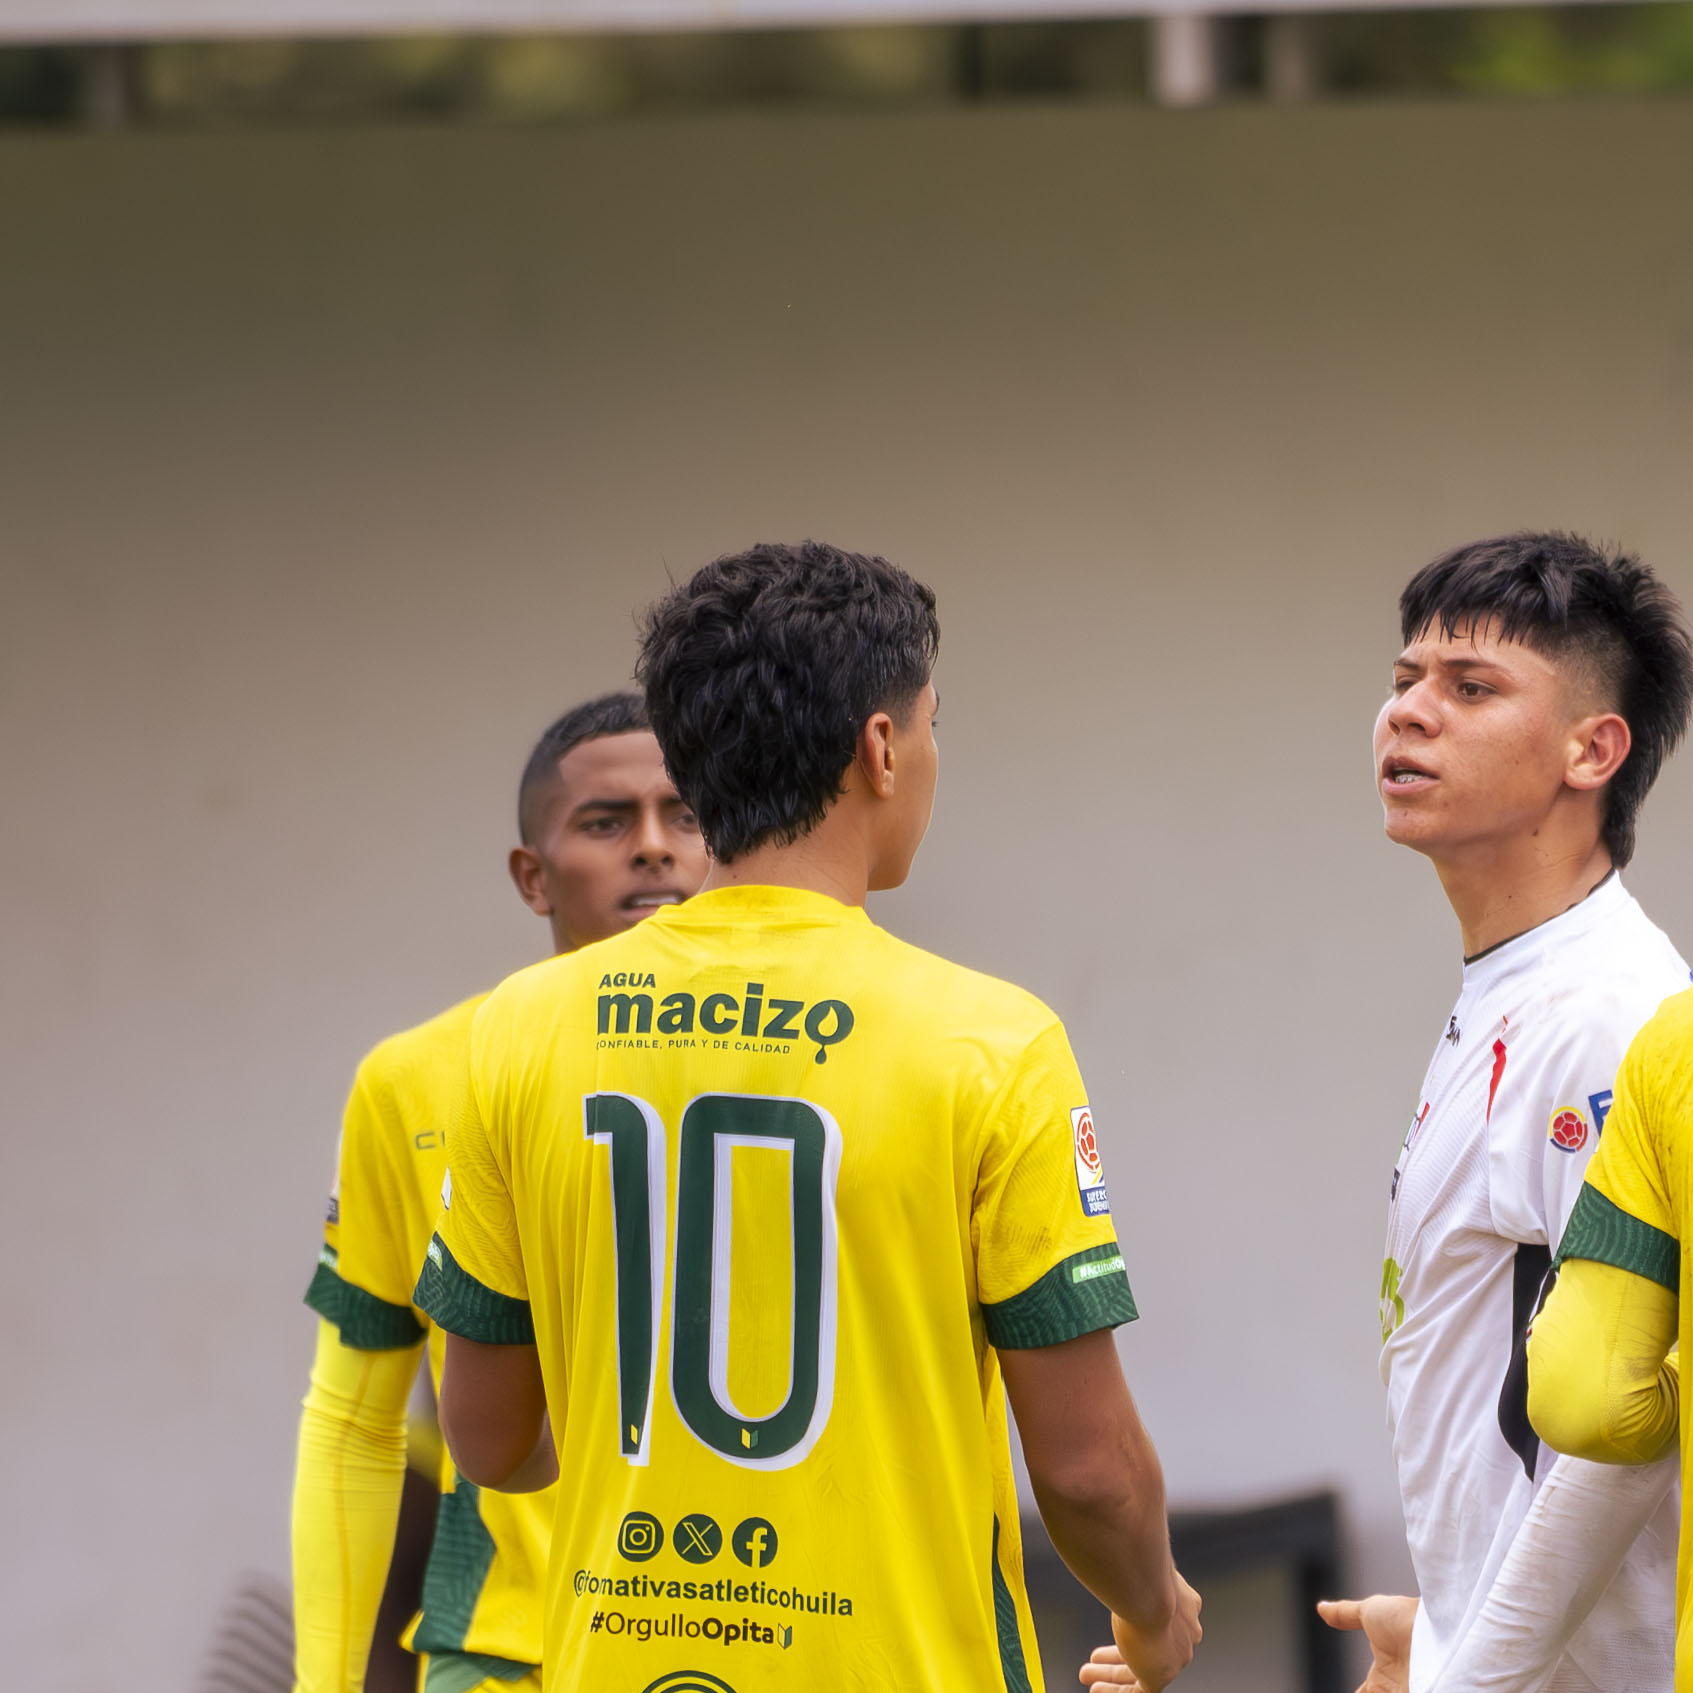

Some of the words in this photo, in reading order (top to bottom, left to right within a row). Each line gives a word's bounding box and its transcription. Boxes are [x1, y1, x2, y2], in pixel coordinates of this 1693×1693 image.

[598, 972, 656, 989] AGUA
[597, 982, 855, 1064] macizo
[668, 1039, 696, 1049] PURA
[700, 1039, 708, 1049] Y
[713, 1040, 729, 1050] DE
[734, 1042, 791, 1055] CALIDAD
[583, 1092, 843, 1471] 10
[590, 1611, 774, 1646] #OrgulloOpita
